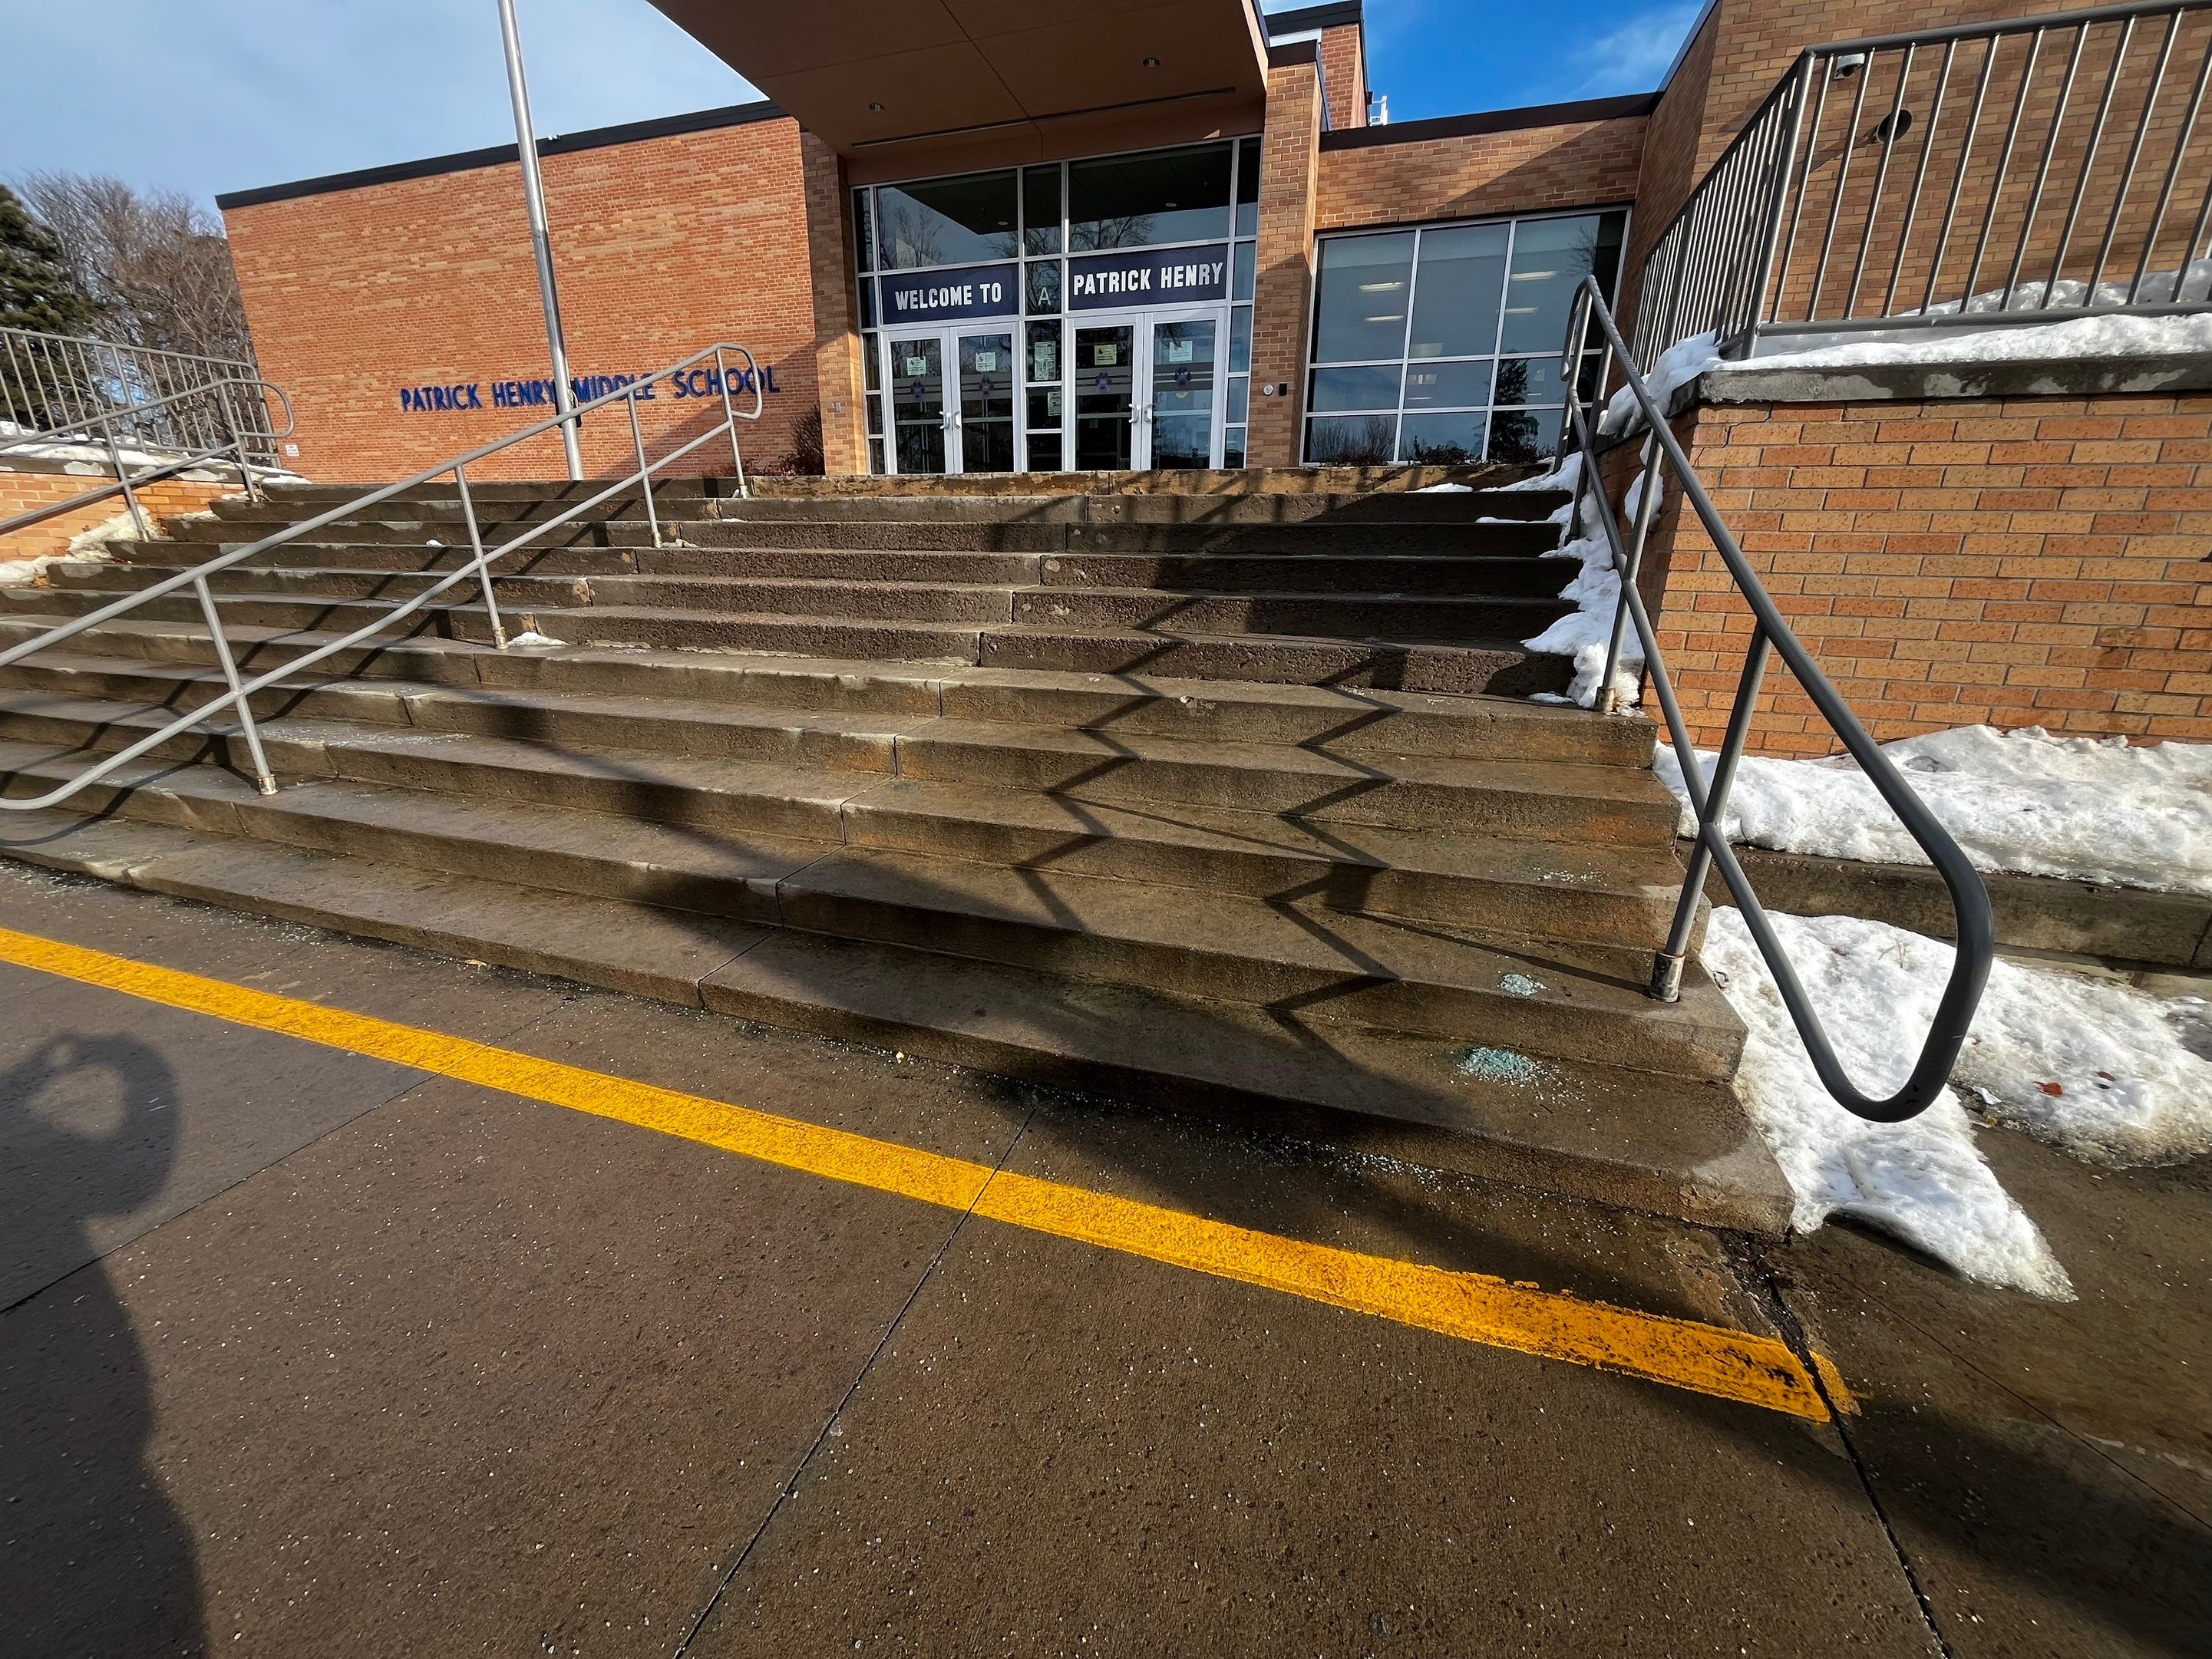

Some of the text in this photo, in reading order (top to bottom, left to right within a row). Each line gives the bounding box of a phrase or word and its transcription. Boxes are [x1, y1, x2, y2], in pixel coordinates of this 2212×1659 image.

[1073, 262, 1223, 295] PATRICK HENRY
[895, 282, 1002, 311] WELCOME TO
[1038, 287, 1052, 306] A
[400, 384, 484, 413] PATRICK
[491, 378, 556, 408] HENRY
[672, 364, 781, 399] SCHOOL
